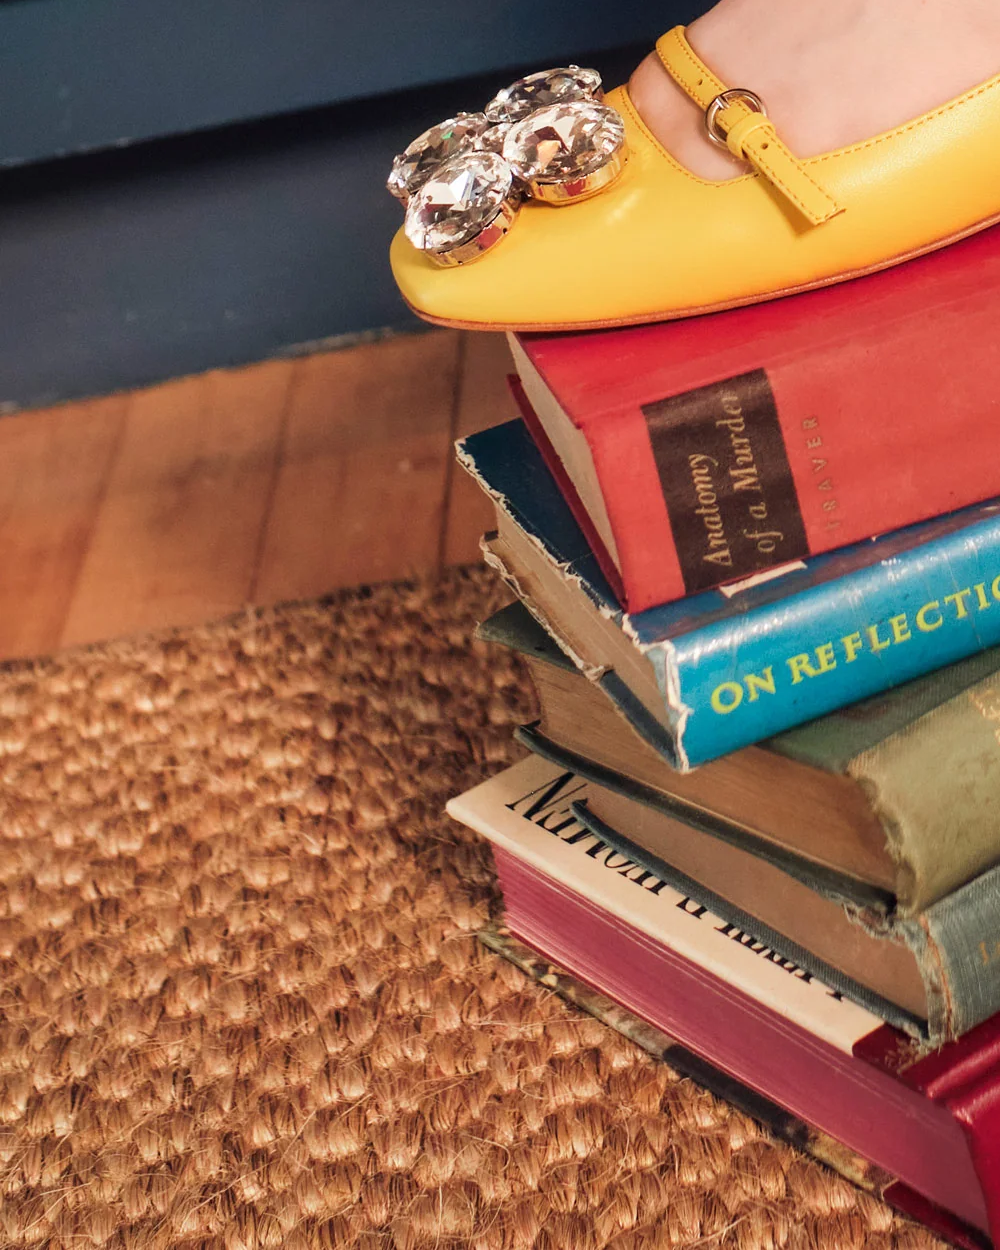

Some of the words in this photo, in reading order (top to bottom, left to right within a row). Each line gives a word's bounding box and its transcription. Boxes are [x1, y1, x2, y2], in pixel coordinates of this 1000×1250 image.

[716, 389, 762, 493] Murder
[688, 452, 733, 567] Anatomy
[749, 500, 768, 520] a
[743, 528, 783, 554] of
[710, 666, 776, 714] ON
